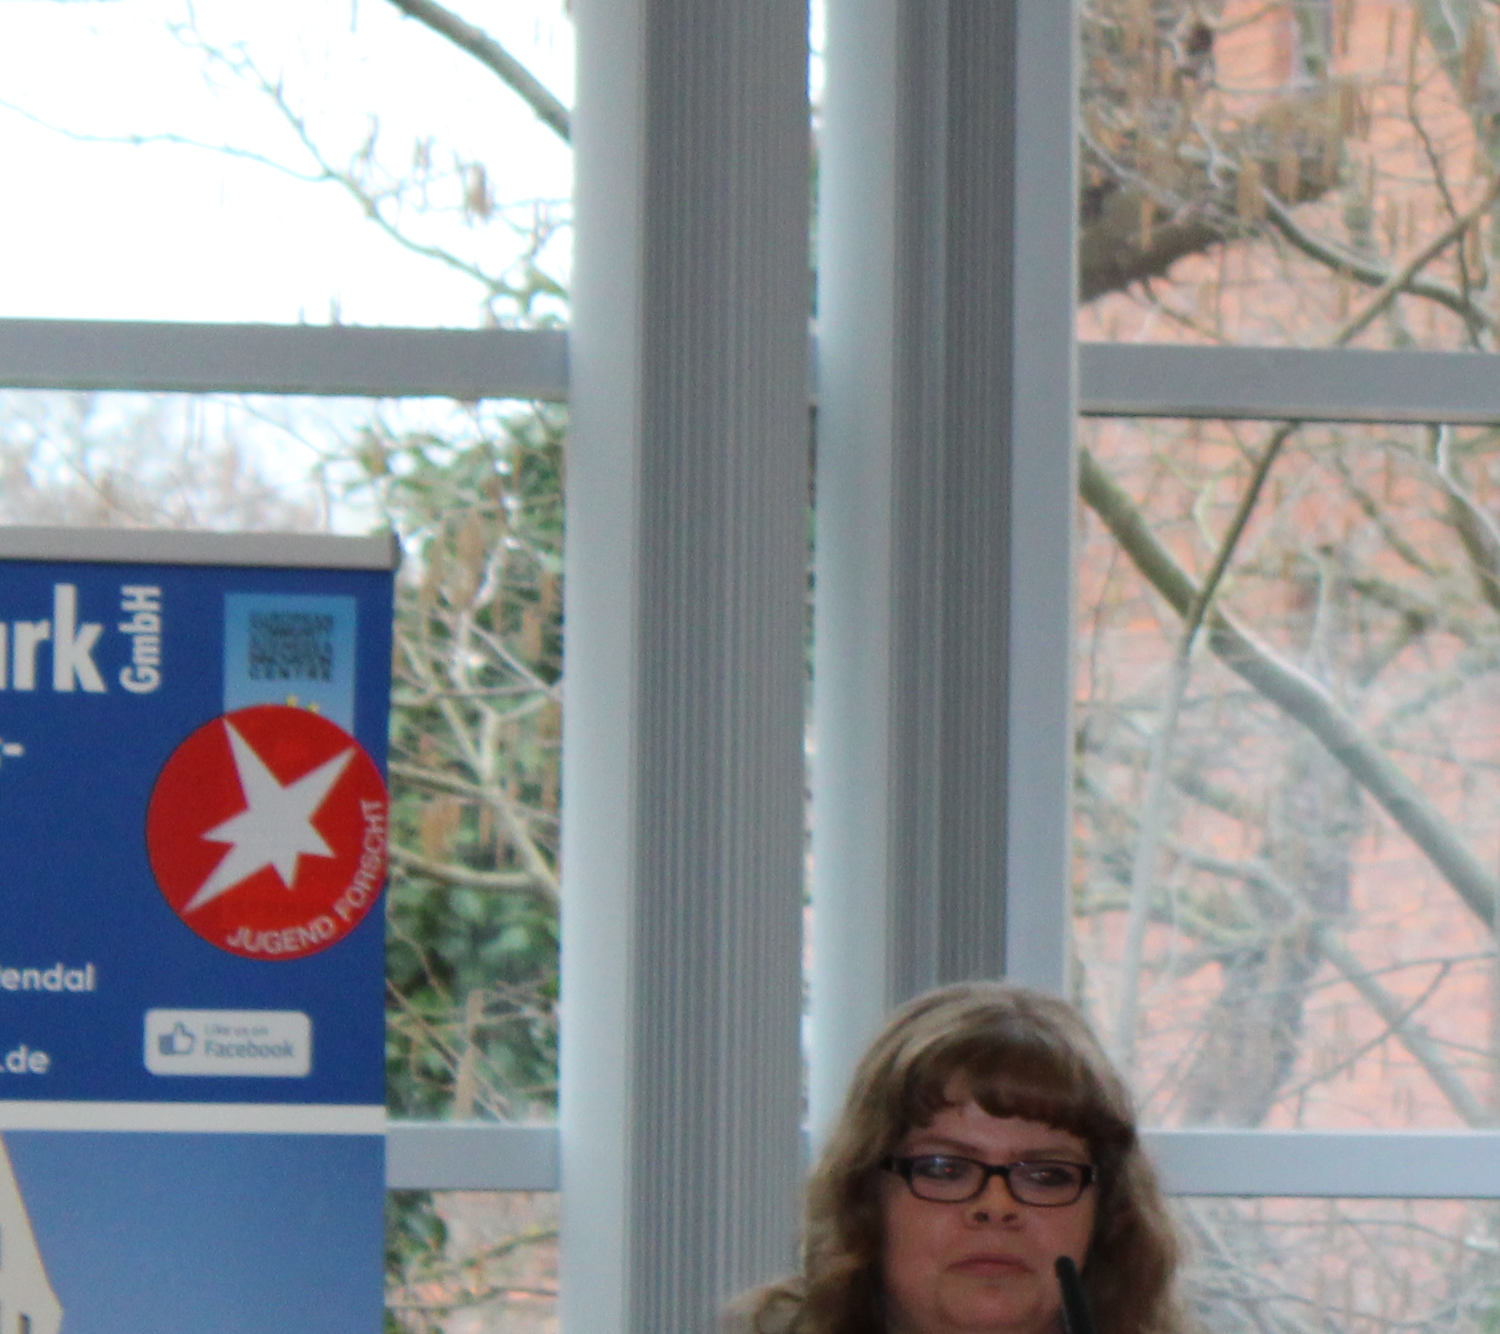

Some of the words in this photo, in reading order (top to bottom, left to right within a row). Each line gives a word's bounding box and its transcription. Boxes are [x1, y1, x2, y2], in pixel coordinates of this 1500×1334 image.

[118, 584, 162, 694] GmbH
[226, 915, 336, 954] JUGEND
[333, 798, 385, 922] FORSCHT
[205, 1038, 295, 1058] Facebook
